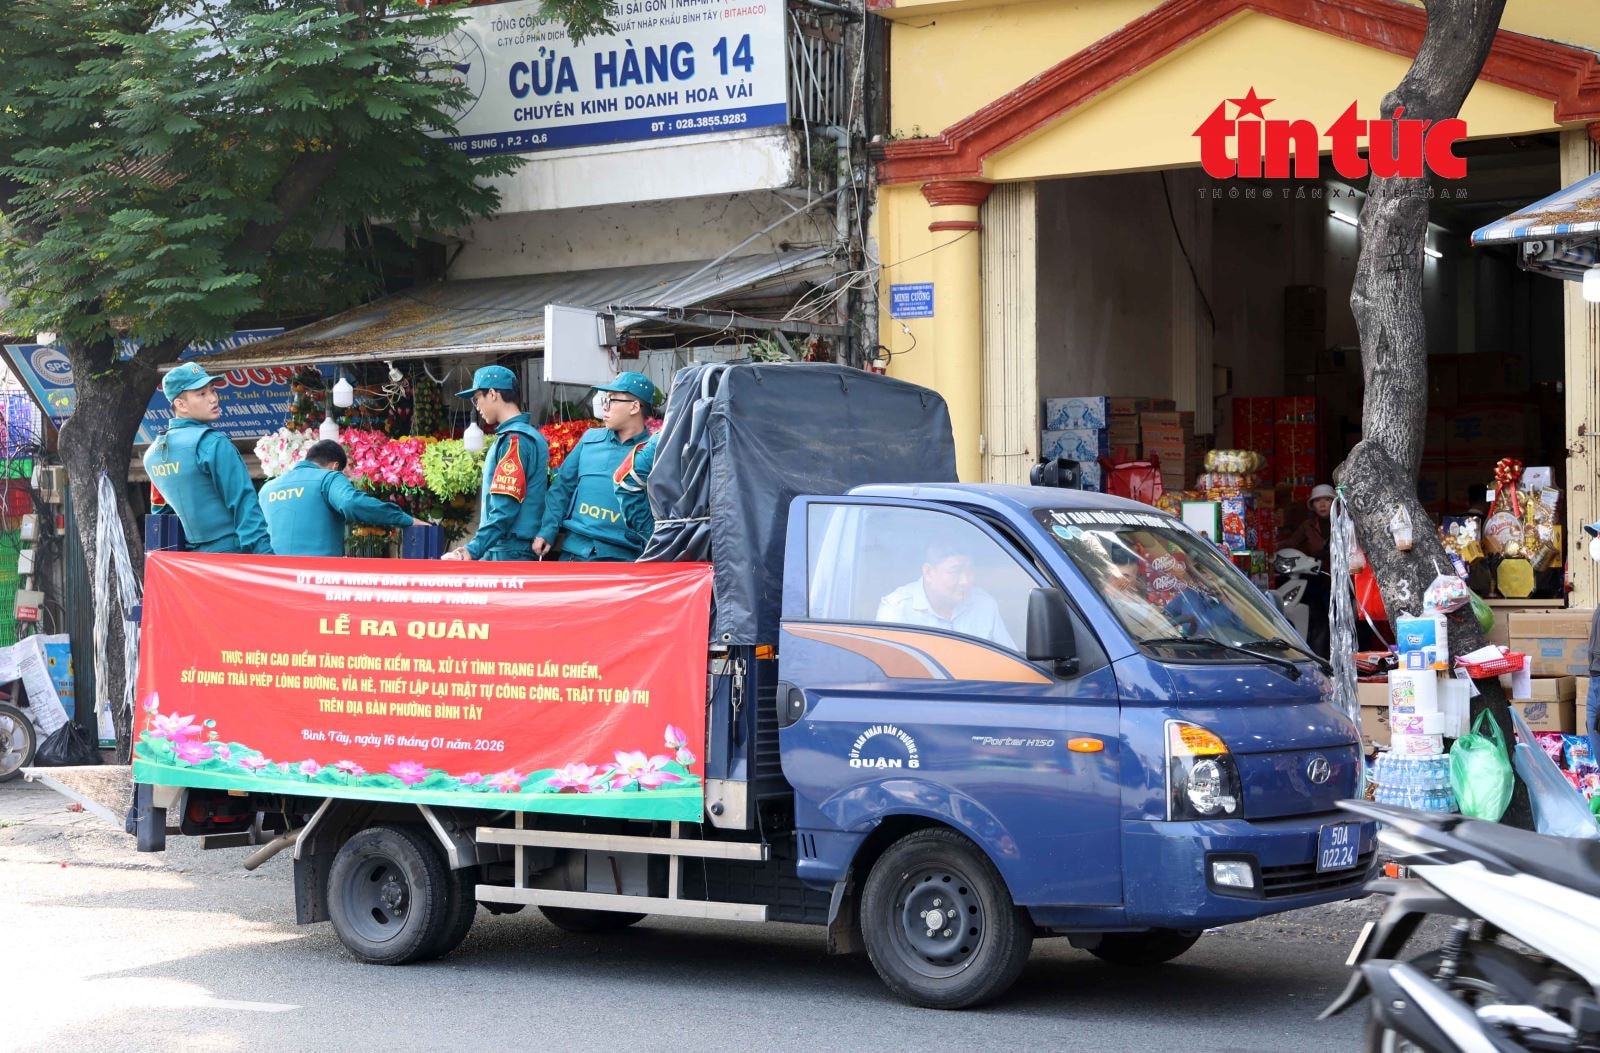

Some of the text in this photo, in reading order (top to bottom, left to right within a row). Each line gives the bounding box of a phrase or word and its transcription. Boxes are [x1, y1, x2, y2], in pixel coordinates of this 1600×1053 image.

[702, 10, 718, 21] TÂY
[509, 33, 755, 99] CỬA HÀNG 14
[513, 78, 753, 122] CHUYÊN KINH DOANH HOA VẢI
[651, 121, 666, 132] ĐT
[675, 112, 748, 130] 028.3855.9283
[471, 138, 498, 149] SUNG
[531, 133, 548, 144] Q.6
[46, 361, 71, 373] SPC
[150, 461, 180, 477] DQTV
[268, 486, 305, 502] DQTV
[579, 502, 621, 523] DQTV
[1397, 578, 1411, 601] 3
[319, 613, 490, 640] LỄ RA QUÂN
[221, 649, 603, 681] THỰC HIỆN CAO ĐIỂM TĂNG CƯỜNG KIỂM TRA, XỬ LÝ TÌNH TRẠNG LẤN CHIẾM,
[181, 666, 197, 683] SỬ
[197, 670, 225, 687] DỤNG
[227, 670, 248, 687] TRÁI
[249, 671, 274, 688] PHÉP
[275, 672, 302, 689] LÒNG
[302, 673, 340, 692] ĐƯỜNG,
[379, 676, 408, 694] THIẾT
[409, 678, 430, 698] LẬP
[431, 681, 449, 699] LẠI
[450, 681, 478, 700] TRẬT
[479, 683, 495, 702] TỰ
[495, 682, 527, 701] CÔNG
[528, 684, 564, 704] CỘNG,
[565, 685, 595, 705] TRẬT
[596, 688, 614, 706] TỰ
[614, 687, 631, 704] ĐÔ
[632, 689, 650, 708] THỊ
[319, 696, 483, 721] TRÊN ĐỊA BÀN PHƯỜNG BÌNH TÂY
[301, 729, 327, 742] Bình
[354, 732, 382, 748] ngày
[383, 734, 395, 746] 16
[397, 732, 430, 750] tháng
[431, 736, 444, 749] 01
[446, 738, 473, 751] năm
[474, 739, 505, 752] 2026
[853, 734, 867, 750] BAN
[863, 724, 883, 740] NHÂN
[883, 724, 898, 736] DÂN
[982, 736, 1026, 746] Porter
[1025, 739, 1056, 747] H150
[849, 756, 920, 770] QUẬN 6
[1331, 825, 1349, 846] 50A
[1321, 845, 1355, 869] 022.24
